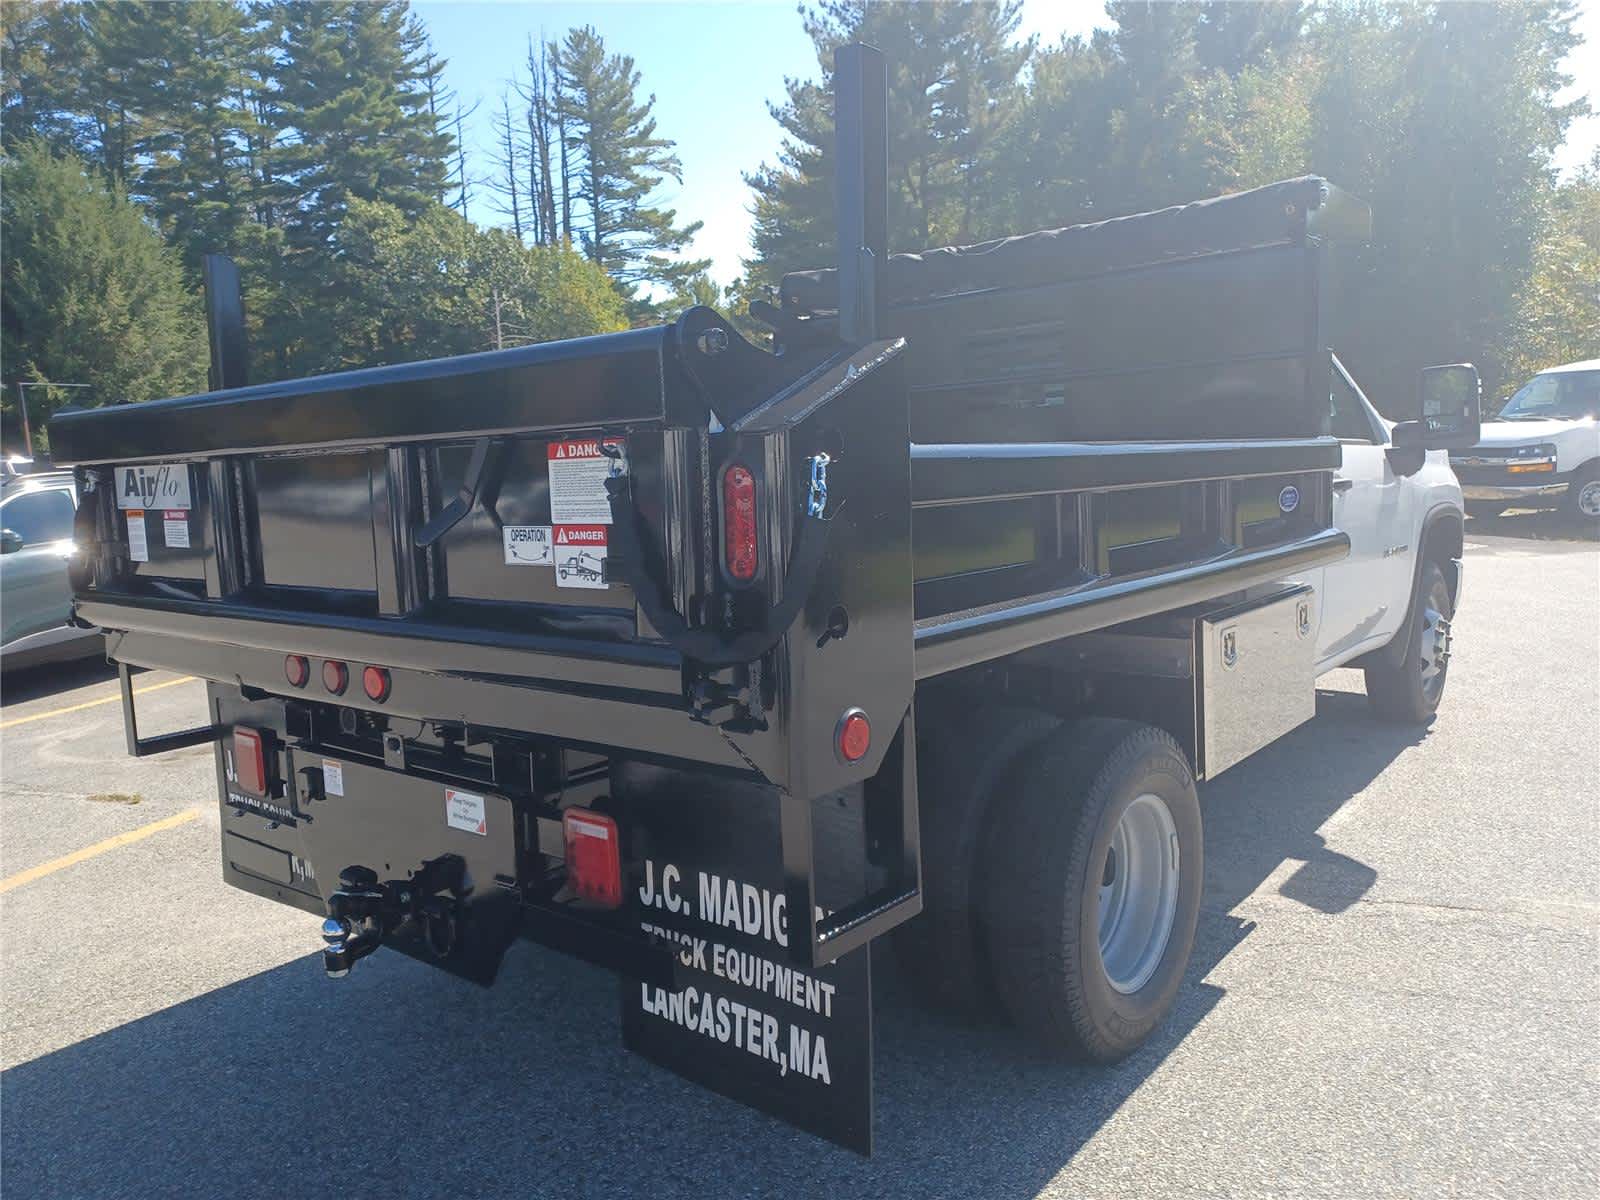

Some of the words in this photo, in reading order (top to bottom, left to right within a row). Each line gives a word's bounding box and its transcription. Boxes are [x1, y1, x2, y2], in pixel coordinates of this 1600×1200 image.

[568, 442, 616, 457] DANG
[124, 466, 178, 508] Airflo
[510, 528, 546, 543] OPERATION
[568, 530, 604, 541] DANGER
[639, 859, 690, 916] J.C.
[712, 943, 836, 1018] EQUIPMENT
